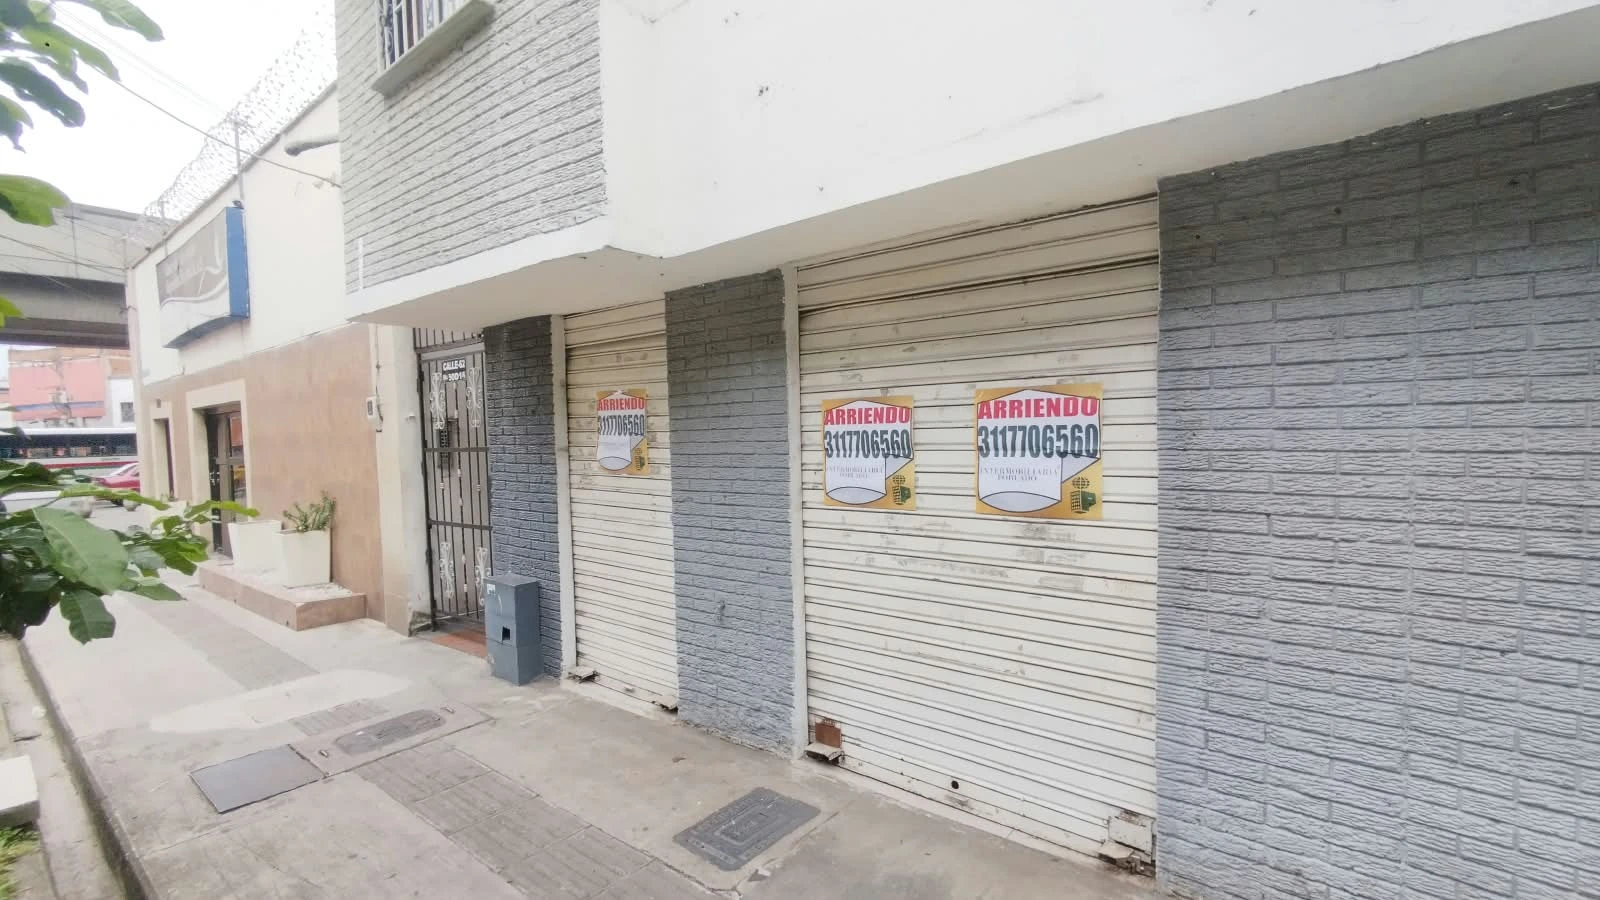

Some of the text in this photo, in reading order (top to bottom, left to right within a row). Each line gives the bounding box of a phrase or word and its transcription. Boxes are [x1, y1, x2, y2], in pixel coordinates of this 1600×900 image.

[597, 398, 645, 411] ARRIENDO
[977, 397, 1098, 419] ARRIENDO
[598, 414, 645, 436] 3117706560
[824, 407, 911, 425] ARRIENDO
[824, 429, 912, 458] 3117706560
[978, 424, 1099, 458] 3117706560
